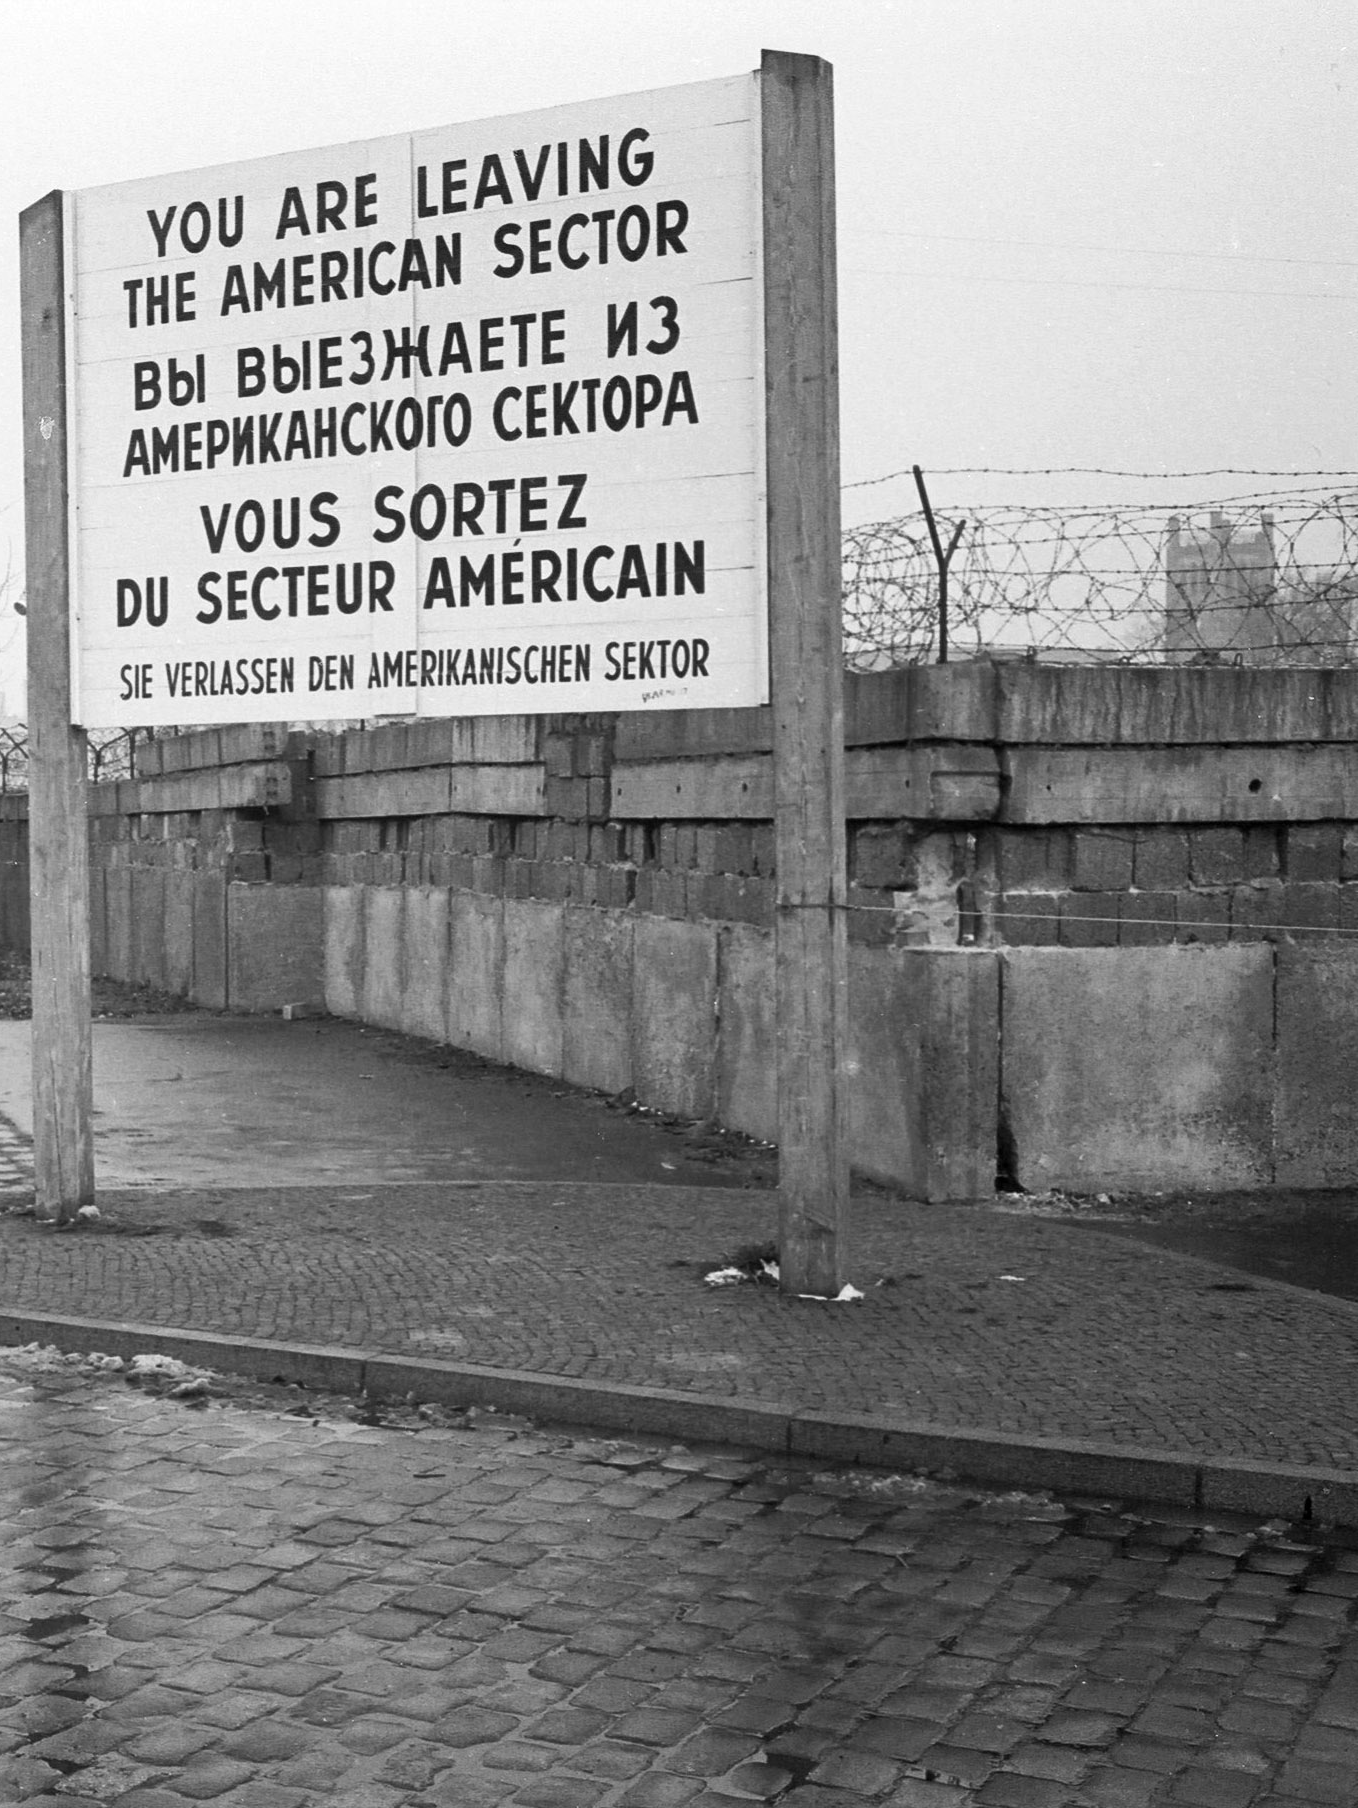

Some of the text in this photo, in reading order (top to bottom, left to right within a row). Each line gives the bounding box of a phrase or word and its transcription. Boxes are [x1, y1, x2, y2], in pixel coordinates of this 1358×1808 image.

[147, 128, 653, 257] YOU ARE LEAVING
[124, 200, 688, 328] THE AMERICAN SECTOR
[135, 296, 679, 410] ВЫ ВЫЕЗЖАЕТЕ ИЗ
[124, 371, 698, 477] АМЕРИКАНСКОГО СЕКТОРА
[200, 474, 587, 553] VOUS SORTEZ
[118, 539, 704, 627] DU SECTEUR AMÉRICAIN
[121, 639, 709, 700] SIE VERLASSEN DEN AMERIKANISCHEN SEKTOR
